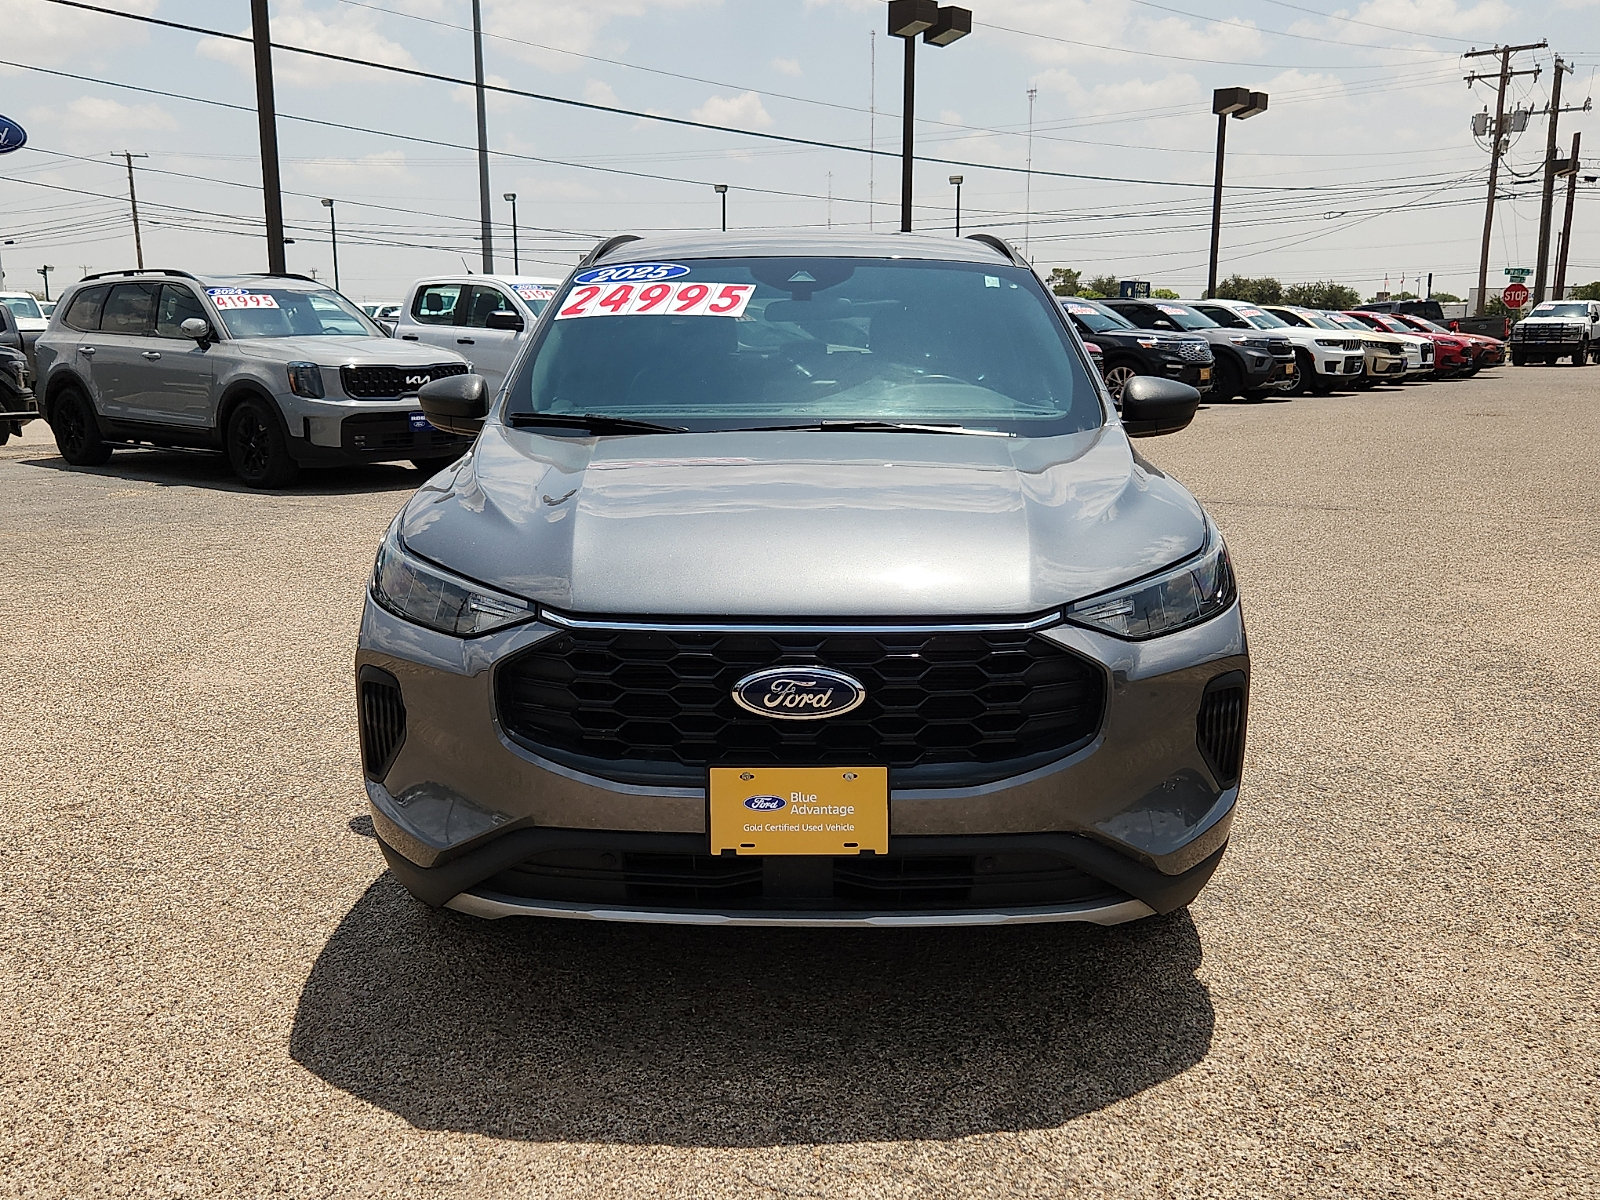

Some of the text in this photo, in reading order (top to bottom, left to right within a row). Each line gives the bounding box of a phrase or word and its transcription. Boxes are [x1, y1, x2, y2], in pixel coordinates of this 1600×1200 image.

[589, 265, 675, 283] 2025
[213, 287, 243, 295] 2024
[1504, 291, 1528, 301] STOP
[216, 295, 274, 308] 41995
[560, 284, 751, 316] 24995
[406, 375, 430, 384] KIA
[763, 679, 834, 708] Ford
[751, 797, 779, 809] Ford
[790, 791, 817, 803] Blue
[790, 804, 855, 817] Advantage
[743, 823, 855, 832] Gold Certified Used Vehicle
